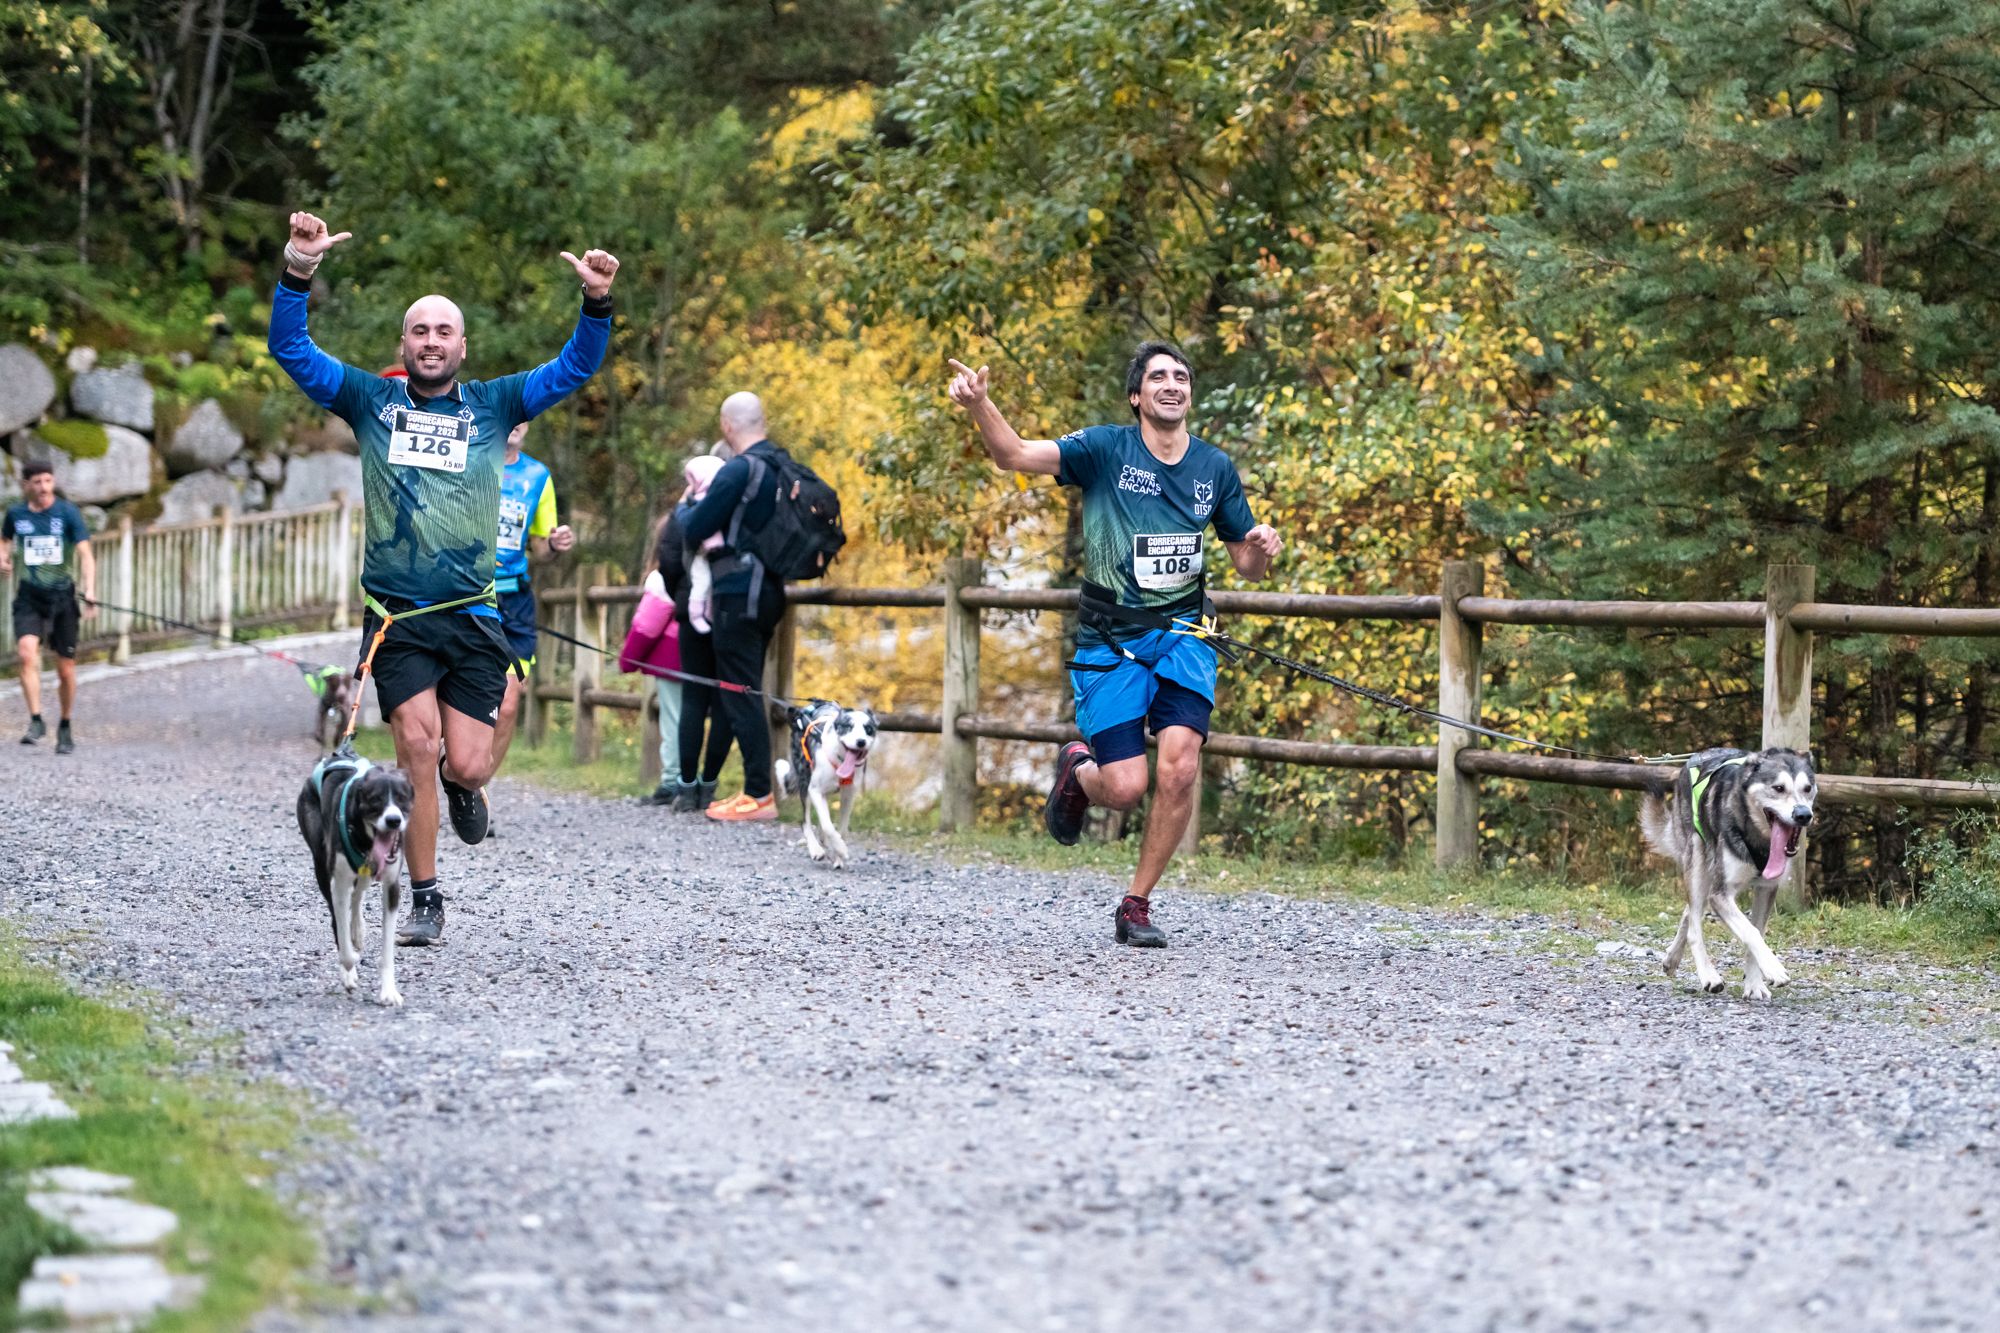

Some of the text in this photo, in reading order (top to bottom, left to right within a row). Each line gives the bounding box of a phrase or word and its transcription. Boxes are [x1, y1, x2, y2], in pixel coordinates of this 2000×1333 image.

[406, 413, 459, 429] CORRECANINS
[405, 422, 458, 438] ENCAMP 2026
[408, 435, 451, 456] 126
[443, 460, 453, 468] 7.5
[1122, 464, 1157, 482] CORRE
[1118, 479, 1161, 497] ENCAMP
[1120, 472, 1162, 492] CANINS
[497, 525, 512, 538] 12
[1147, 536, 1197, 547] CORRECANINS
[1147, 545, 1196, 555] ENCAMP 2026
[1152, 557, 1190, 575] 108
